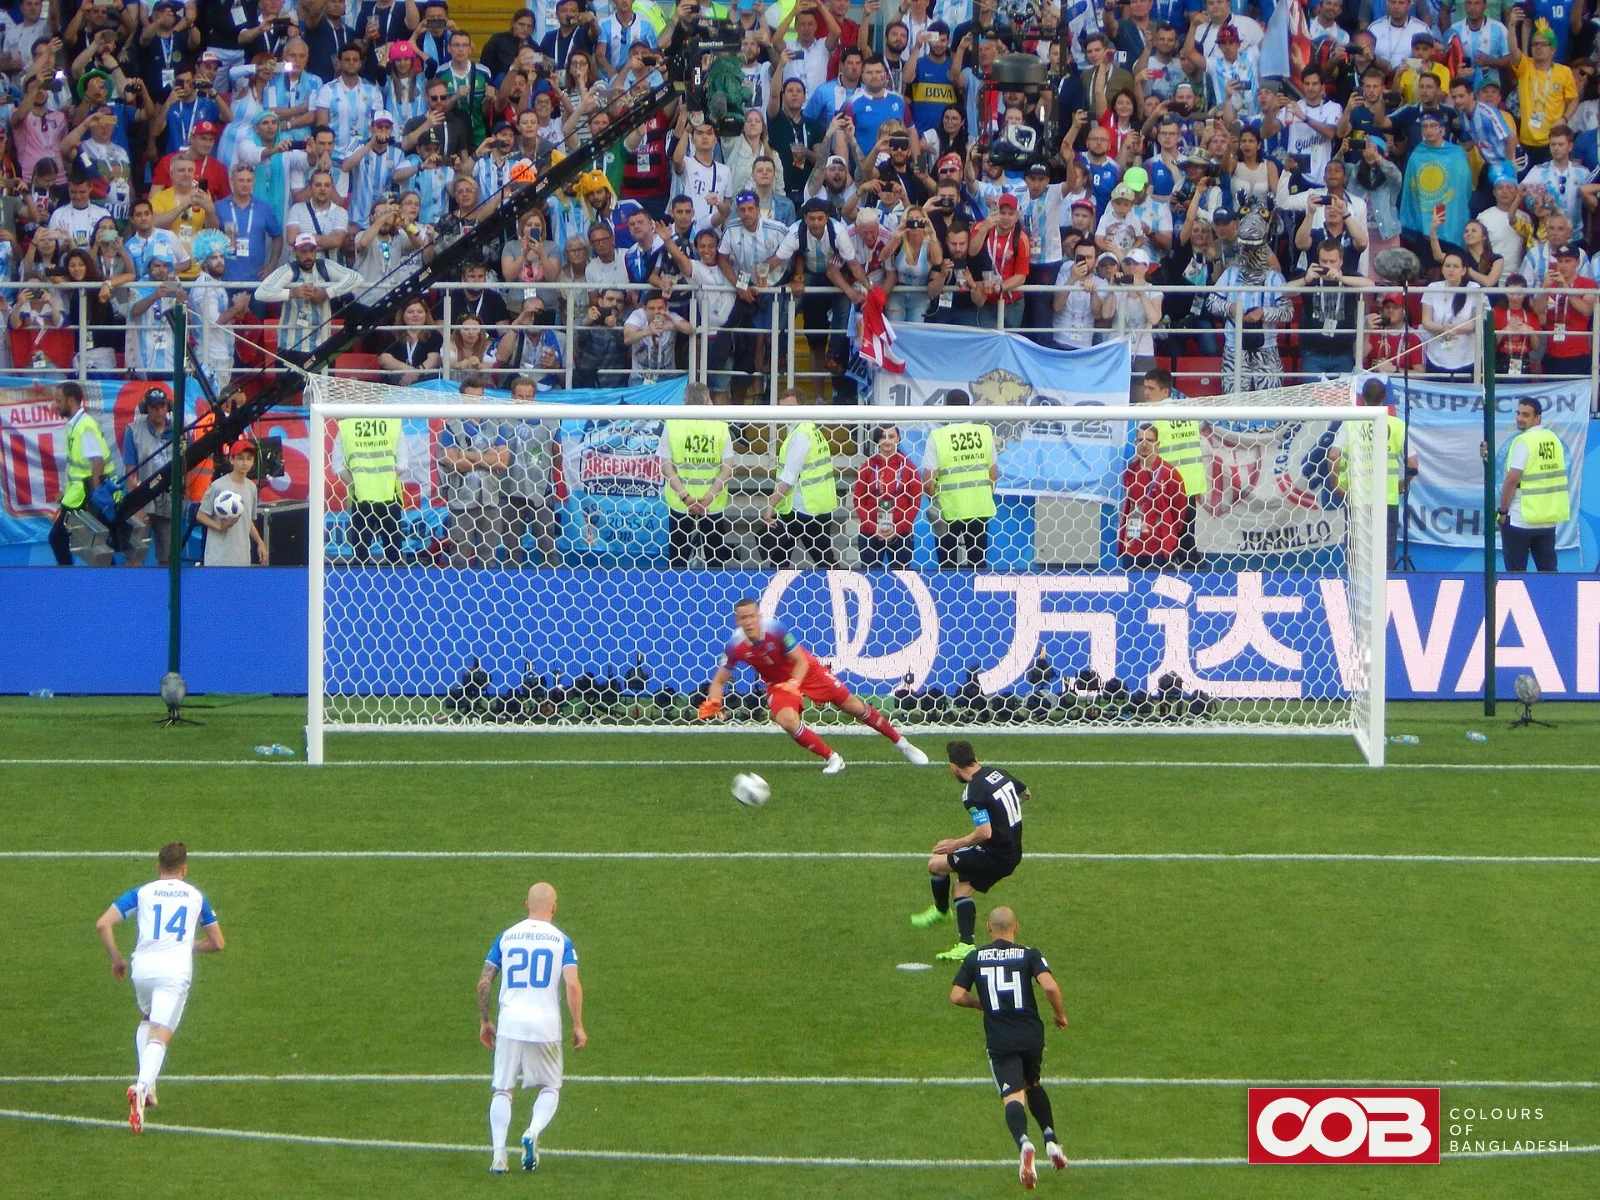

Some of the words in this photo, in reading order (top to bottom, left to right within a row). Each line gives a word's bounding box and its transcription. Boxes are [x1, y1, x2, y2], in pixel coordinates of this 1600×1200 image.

[1552, 5, 1564, 18] 10
[925, 87, 953, 99] BBVA
[1093, 174, 1101, 186] 8
[10, 404, 66, 424] ALUM
[354, 420, 388, 437] 5210
[684, 434, 715, 453] 4321
[950, 431, 983, 452] 5253
[953, 453, 985, 461] SEWARD
[583, 452, 661, 482] ARGENTINA
[608, 517, 655, 531] RUSSA
[1238, 520, 1331, 551] JUANILLO
[973, 571, 1304, 700] 万达
[992, 780, 1022, 828] 10
[153, 888, 189, 898] ARNASON
[152, 903, 188, 942] 14
[977, 948, 1025, 961] MASCHERANO
[507, 947, 554, 989] 20
[980, 966, 1023, 1011] 14
